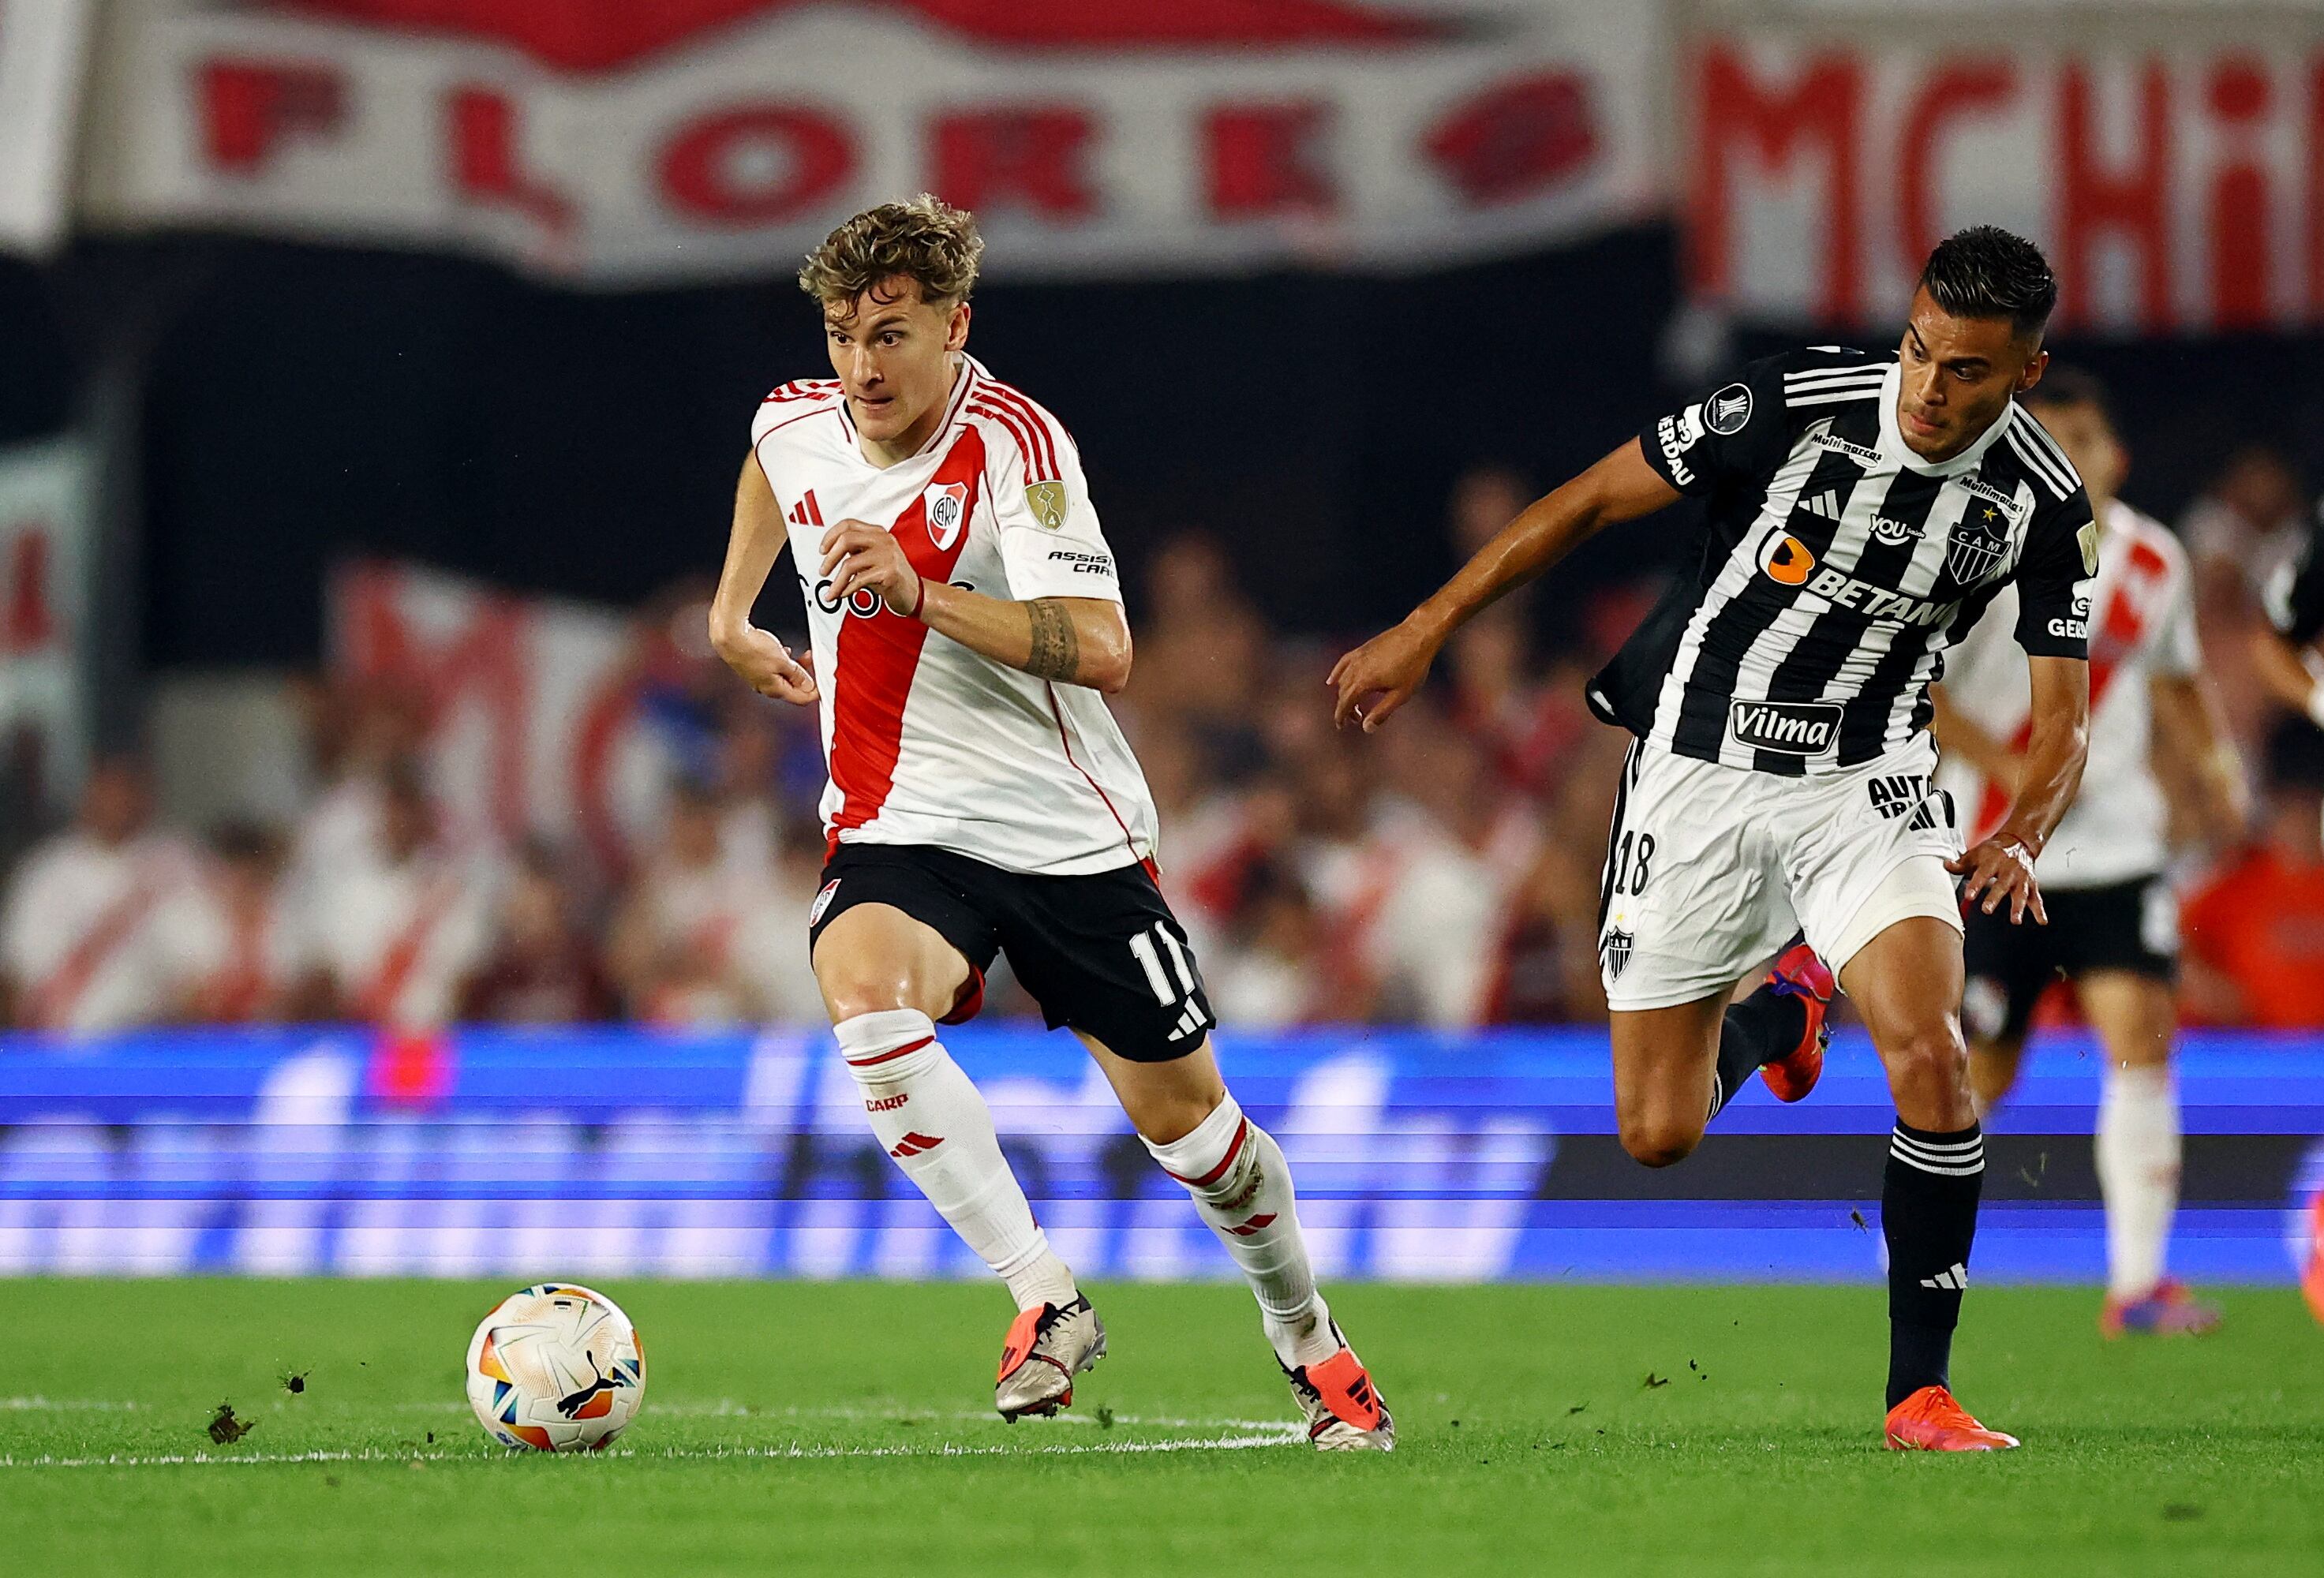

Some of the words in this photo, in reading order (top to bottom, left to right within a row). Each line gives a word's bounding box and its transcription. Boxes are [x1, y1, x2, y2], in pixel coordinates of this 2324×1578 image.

[1869, 514, 1907, 537] YOU
[1737, 705, 1830, 746] Vilma
[1615, 830, 1656, 896] 18
[1129, 919, 1196, 1008] 11
[866, 1094, 909, 1112] CARP
